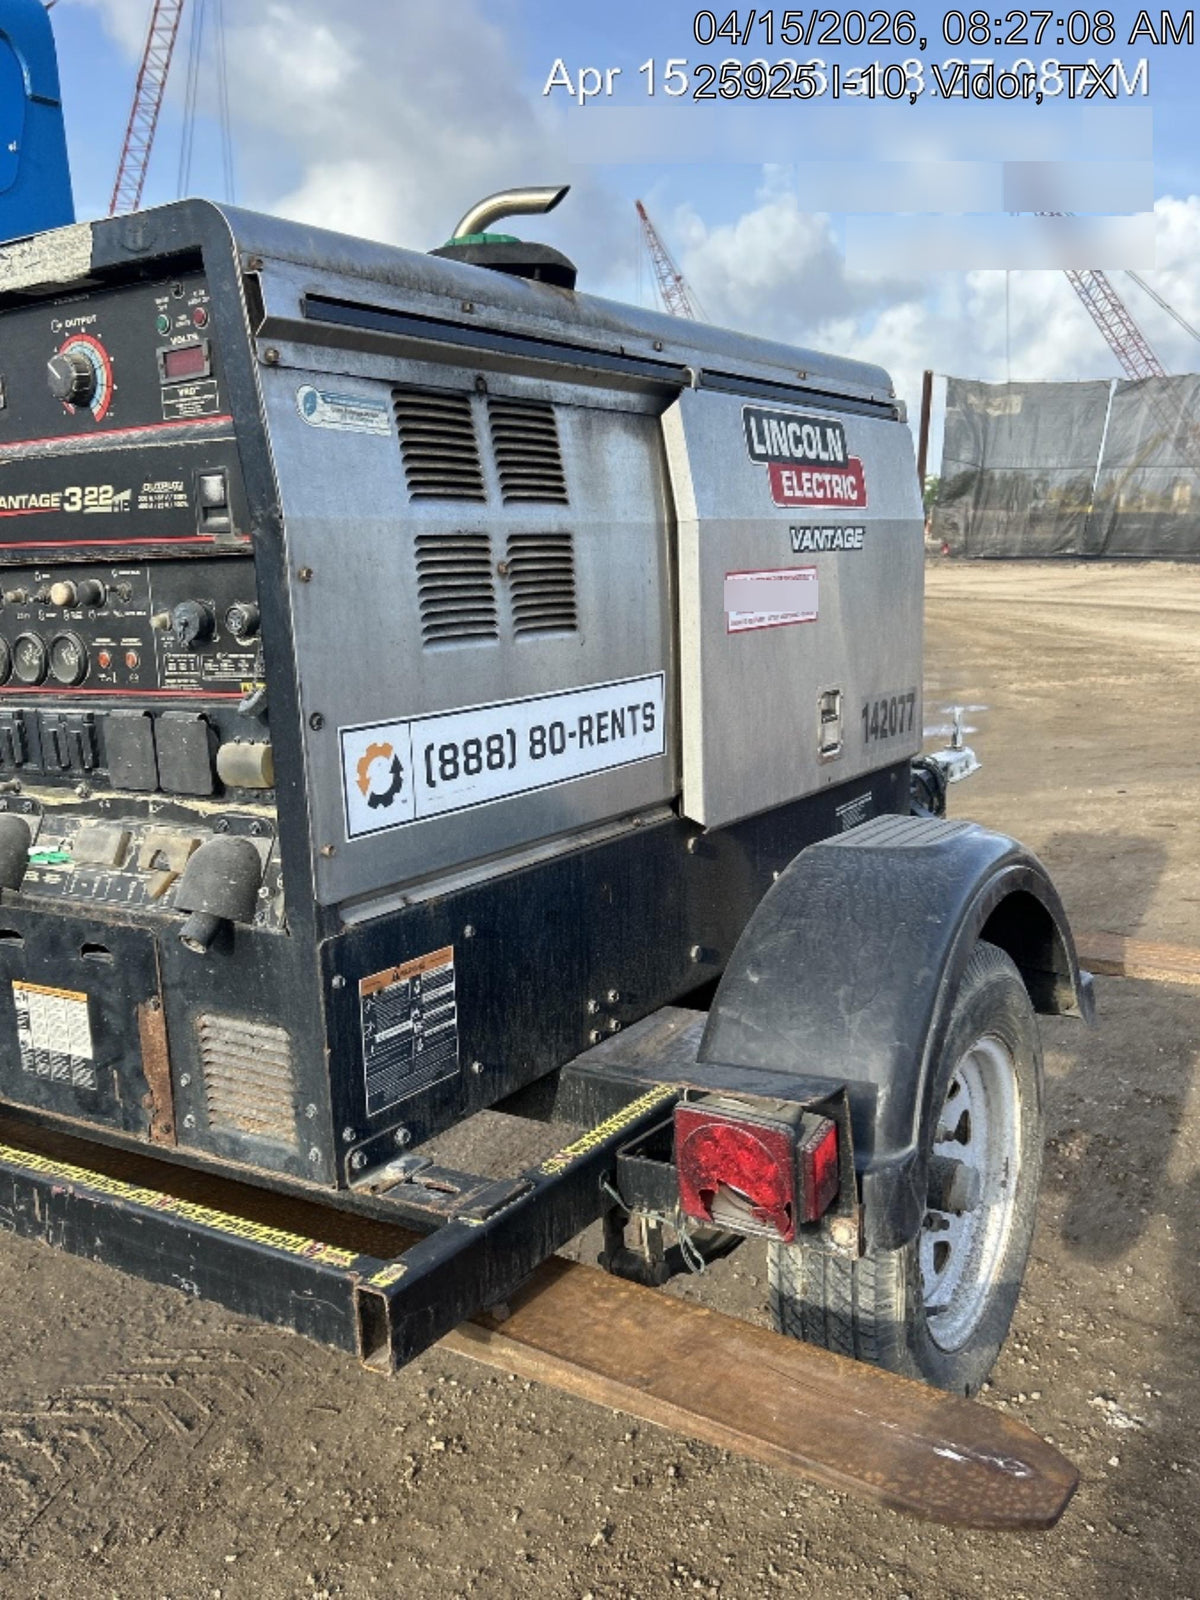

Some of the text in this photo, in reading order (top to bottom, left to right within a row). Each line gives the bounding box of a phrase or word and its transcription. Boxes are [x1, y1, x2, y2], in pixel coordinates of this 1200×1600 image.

[64, 314, 97, 329] OUTPUT
[749, 416, 845, 463] LINCOLN
[63, 485, 115, 513] 322
[781, 470, 858, 500] ELECTRIC
[789, 526, 866, 552] VANTAGE
[861, 692, 916, 744] 142077
[424, 701, 656, 789] (888) 80-RENTS
